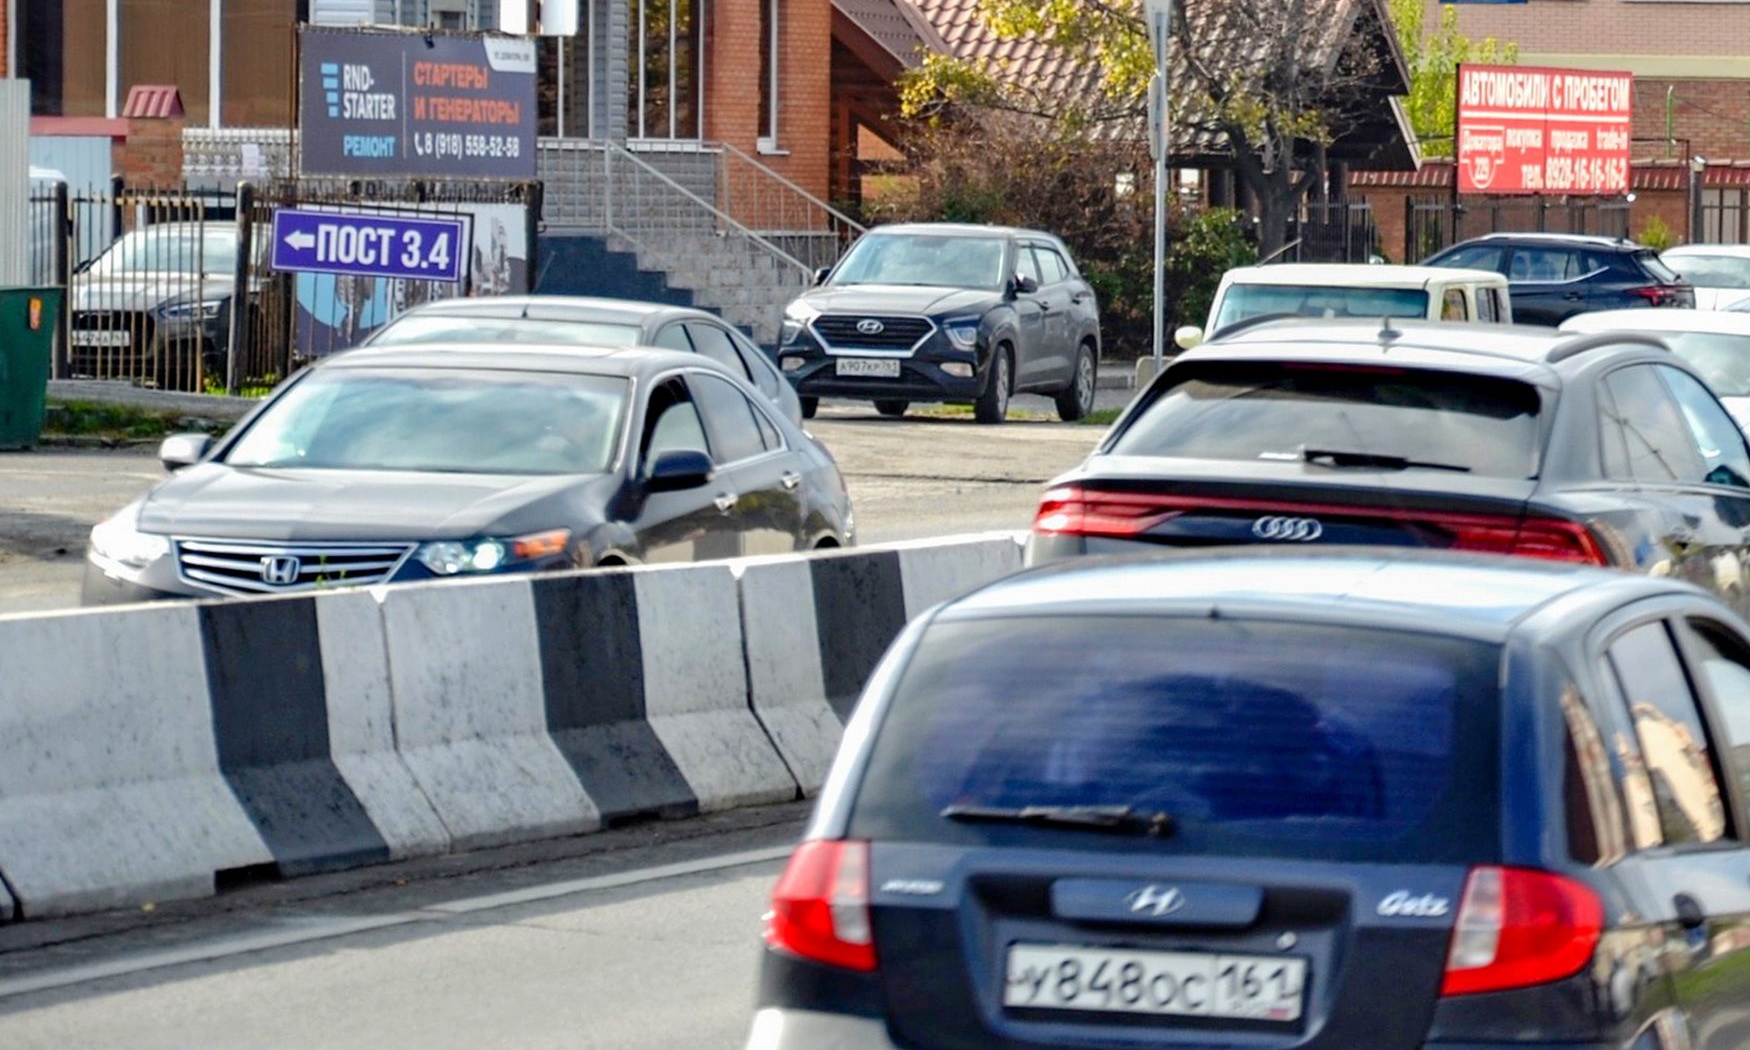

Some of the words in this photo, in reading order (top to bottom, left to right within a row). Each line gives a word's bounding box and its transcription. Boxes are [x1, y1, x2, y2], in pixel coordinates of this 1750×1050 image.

[343, 64, 374, 91] RND-
[414, 62, 488, 89] СТАРТЕРЫ
[1462, 71, 1549, 108] АВТОМОБИЛИ
[1552, 75, 1562, 109] С
[1564, 75, 1630, 111] ПРОБЕГОМ
[343, 93, 395, 121] STARTER
[414, 97, 425, 120] И
[429, 97, 520, 125] ГЕНЕРАТОРЫ
[343, 135, 396, 157] РЕМОНТ
[425, 134, 432, 154] 8
[435, 134, 462, 160] (918)
[1521, 164, 1544, 189] тел.
[316, 224, 395, 266] ПОСТ
[401, 230, 450, 270] 3.4
[1376, 890, 1449, 917] Getz
